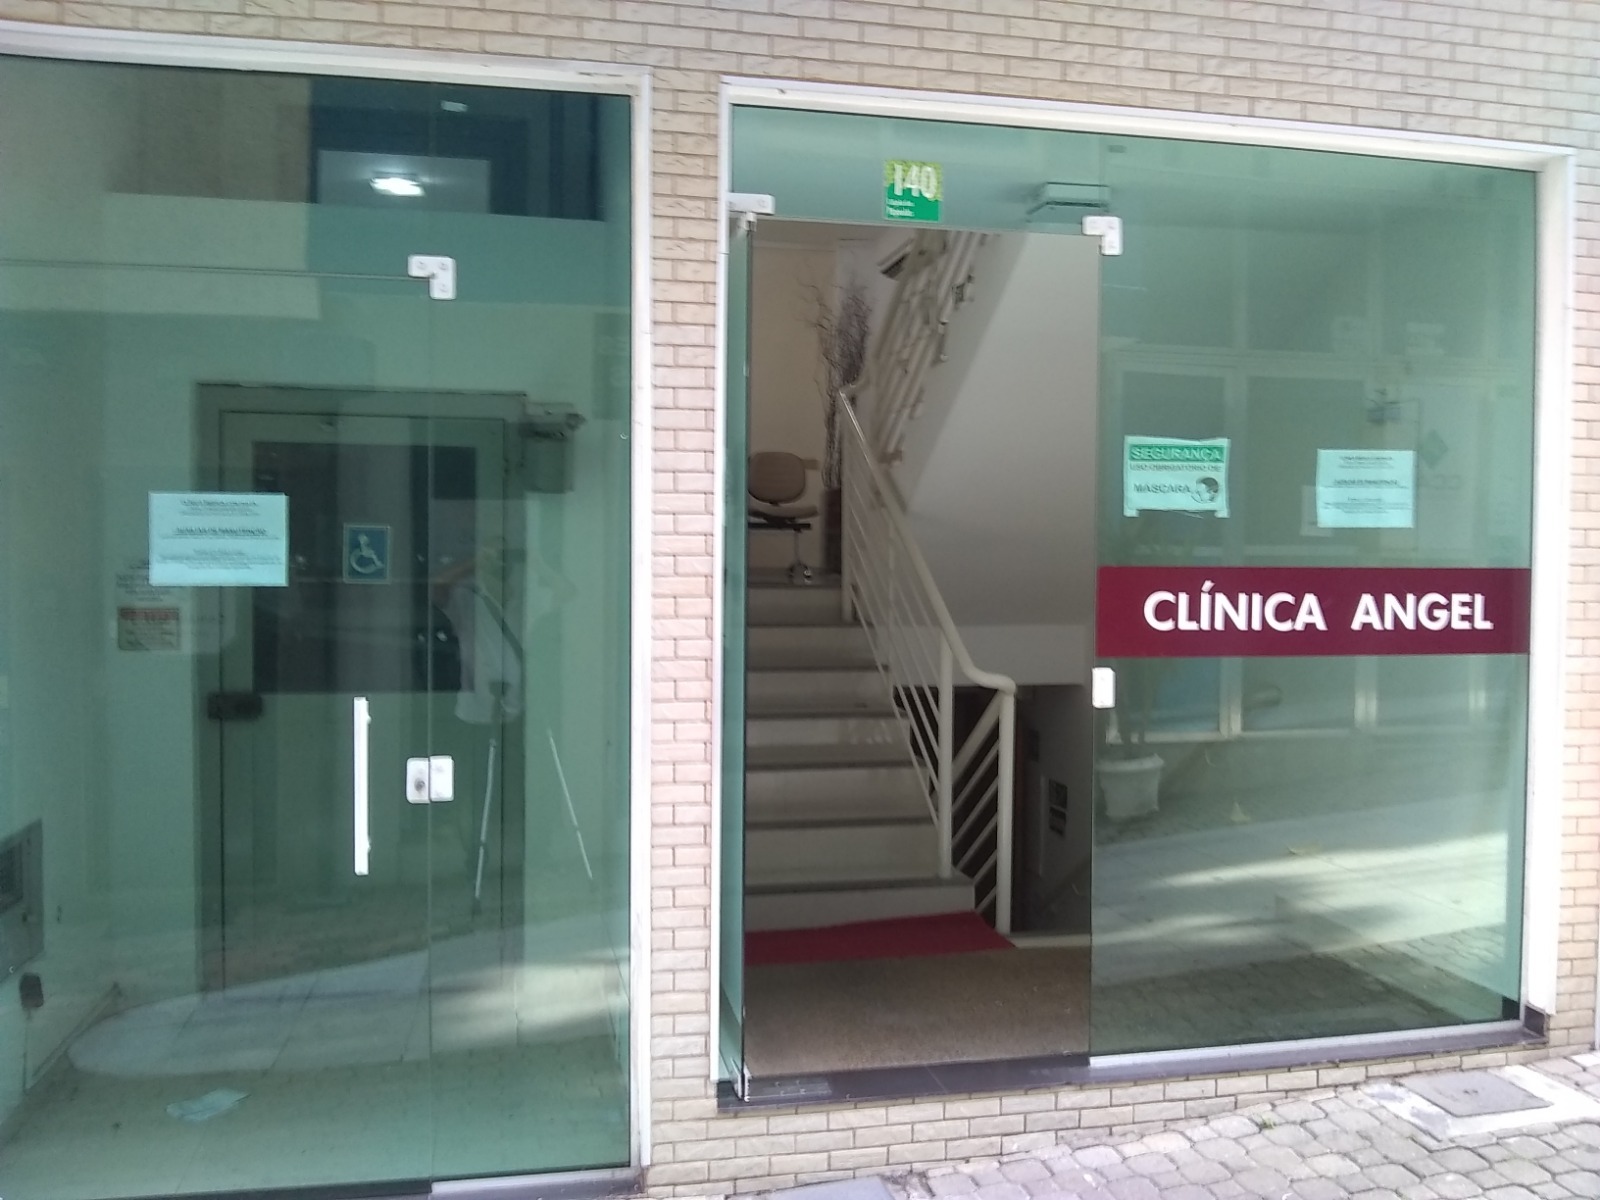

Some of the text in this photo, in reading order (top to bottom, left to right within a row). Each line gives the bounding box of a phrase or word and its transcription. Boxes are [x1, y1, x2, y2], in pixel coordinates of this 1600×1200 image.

[893, 162, 937, 199] 140
[1130, 446, 1221, 463] SEGURANÇA
[1143, 579, 1495, 632] CLÍNICA ANGEL
